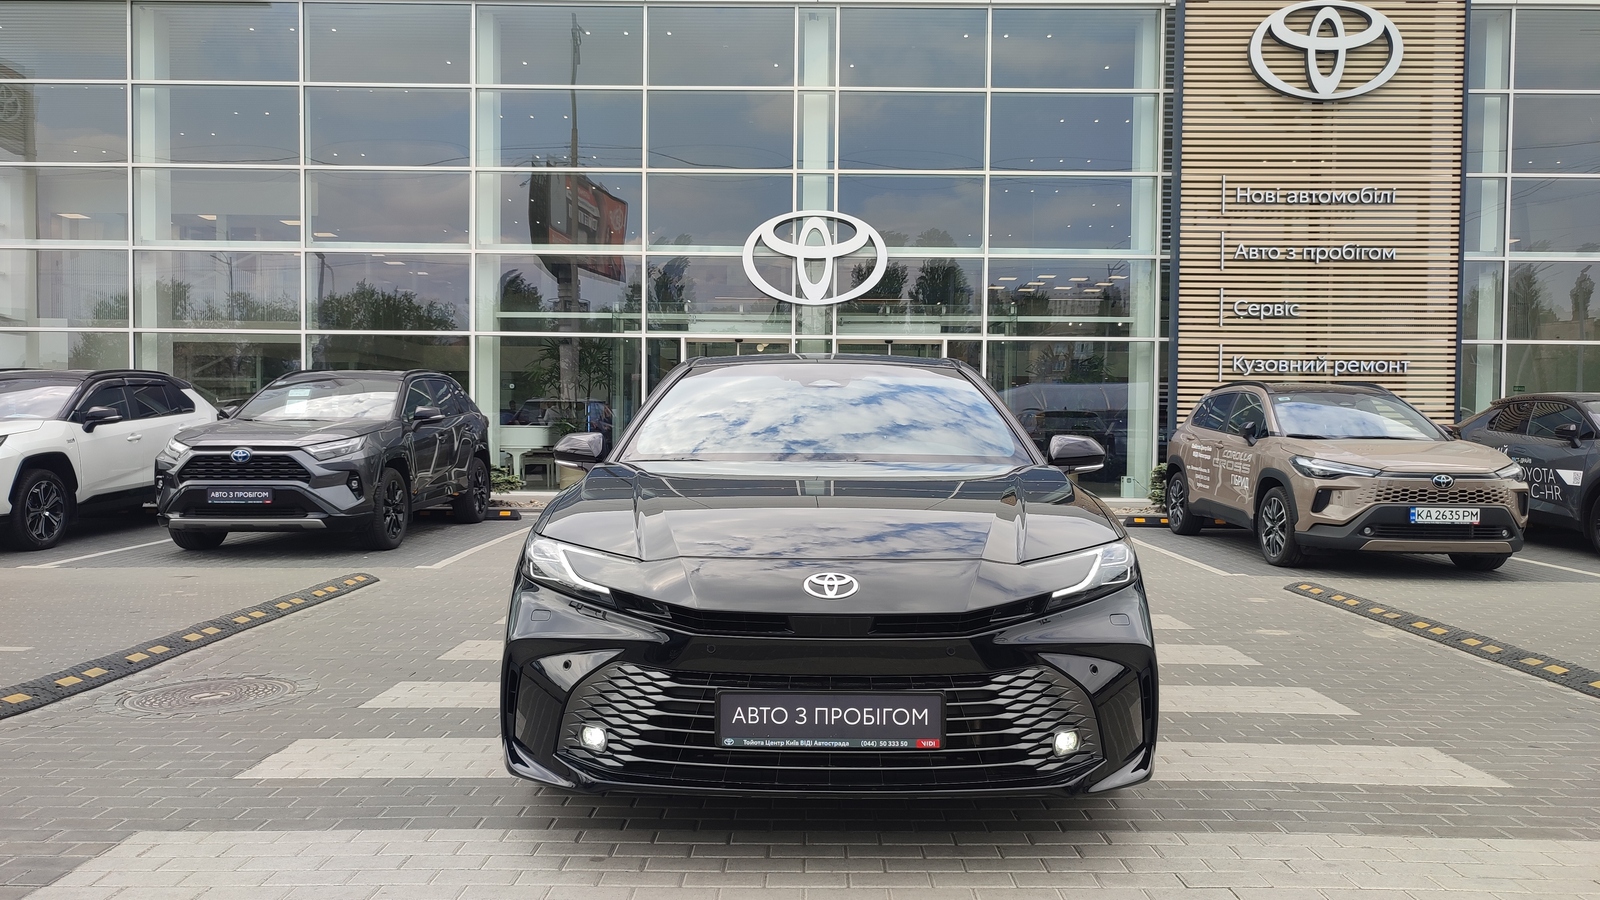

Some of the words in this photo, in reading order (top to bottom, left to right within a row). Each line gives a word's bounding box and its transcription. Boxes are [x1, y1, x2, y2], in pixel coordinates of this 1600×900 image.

[1236, 187, 1280, 203] Нові
[1286, 187, 1397, 204] автомобілі
[1233, 243, 1281, 260] Авто
[1286, 247, 1297, 260] з
[1302, 243, 1397, 264] пробігом
[1233, 300, 1301, 320] Сервіс
[1232, 355, 1328, 376] Кузовний
[1334, 359, 1411, 376] ремонт
[1222, 449, 1253, 463] COROLLA
[1213, 457, 1251, 474] CROSS
[1521, 466, 1556, 484] YOTA
[1531, 483, 1562, 501] C-HR
[732, 706, 789, 725] АВТО
[814, 707, 929, 726] ПРОБІГОМ
[765, 739, 785, 747] Центр
[786, 739, 799, 747] Київ
[814, 740, 850, 748] Автострада
[860, 740, 877, 748] (044)
